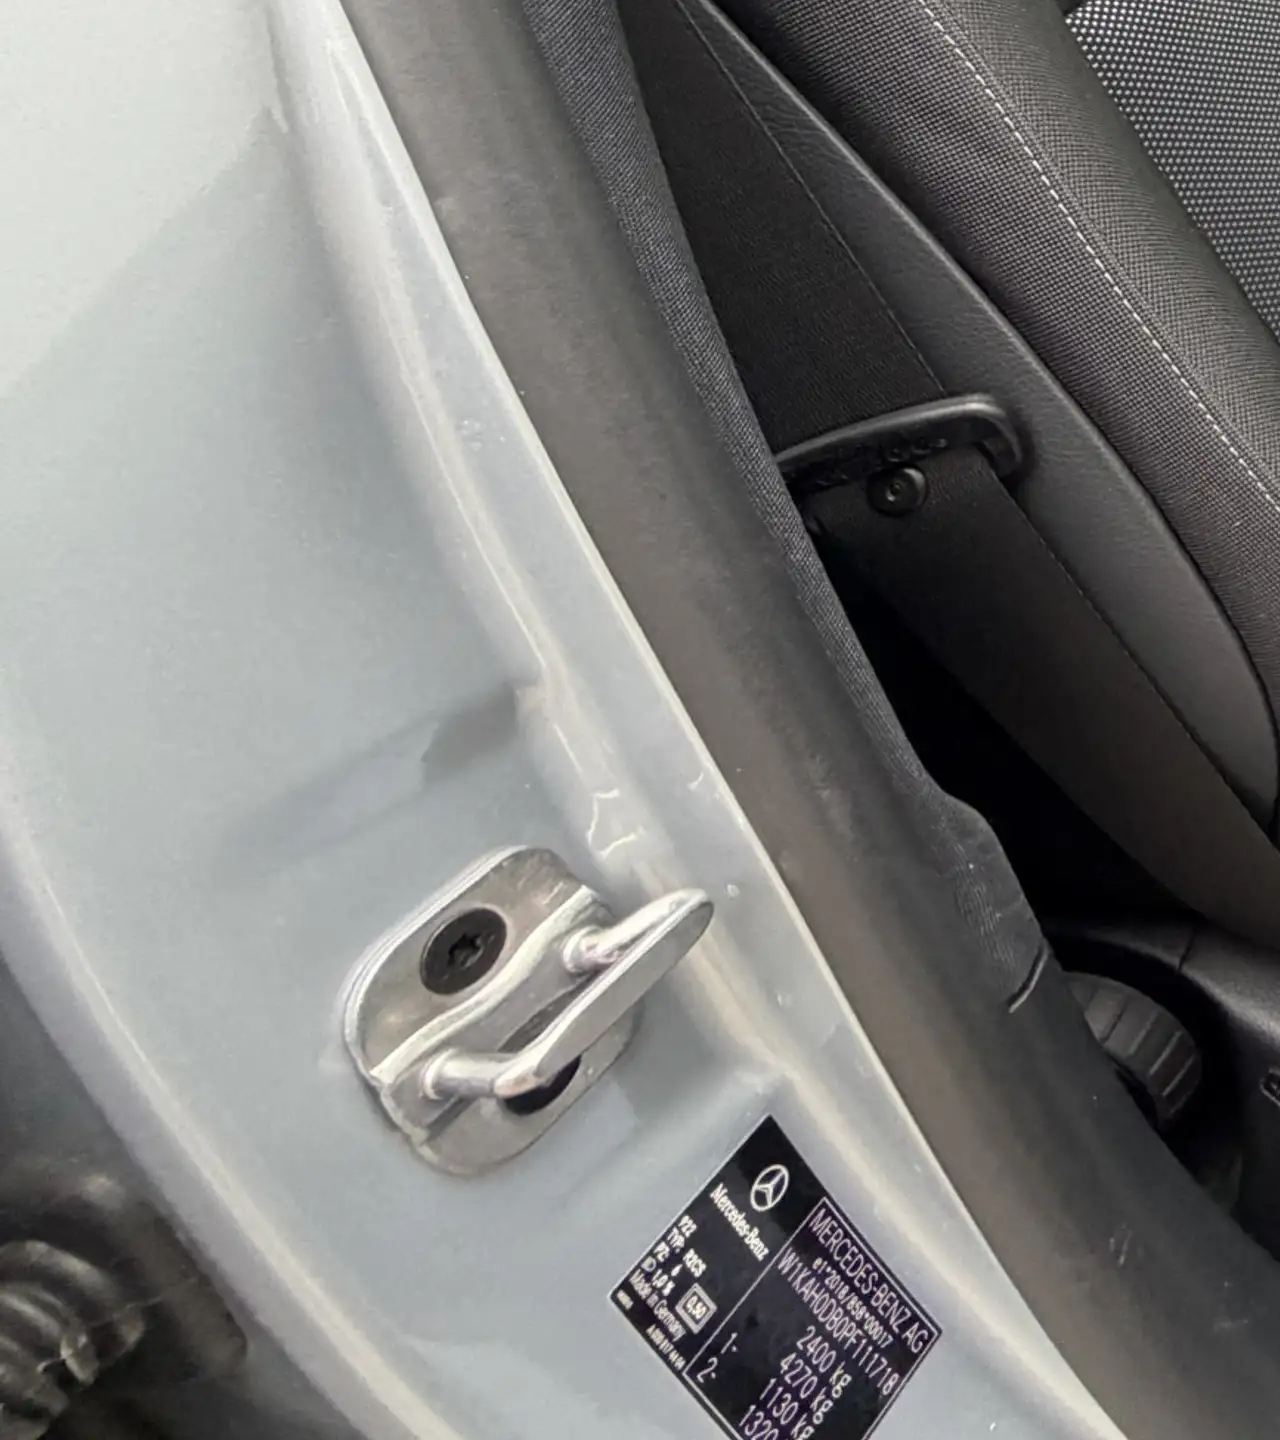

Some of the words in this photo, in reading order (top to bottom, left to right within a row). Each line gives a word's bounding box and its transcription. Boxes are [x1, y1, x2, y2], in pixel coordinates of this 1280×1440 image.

[709, 1182, 770, 1261] Mercedes-Benz
[629, 1268, 652, 1300] Made
[653, 1299, 687, 1343] Germany
[810, 1209, 911, 1333] MERCEDES-BENZ
[902, 1322, 929, 1354] AG
[780, 1352, 818, 1400] 4270
[810, 1386, 834, 1425] kg
[796, 1325, 837, 1374] 2400
[829, 1360, 852, 1398] kg
[759, 1377, 798, 1426] 1130
